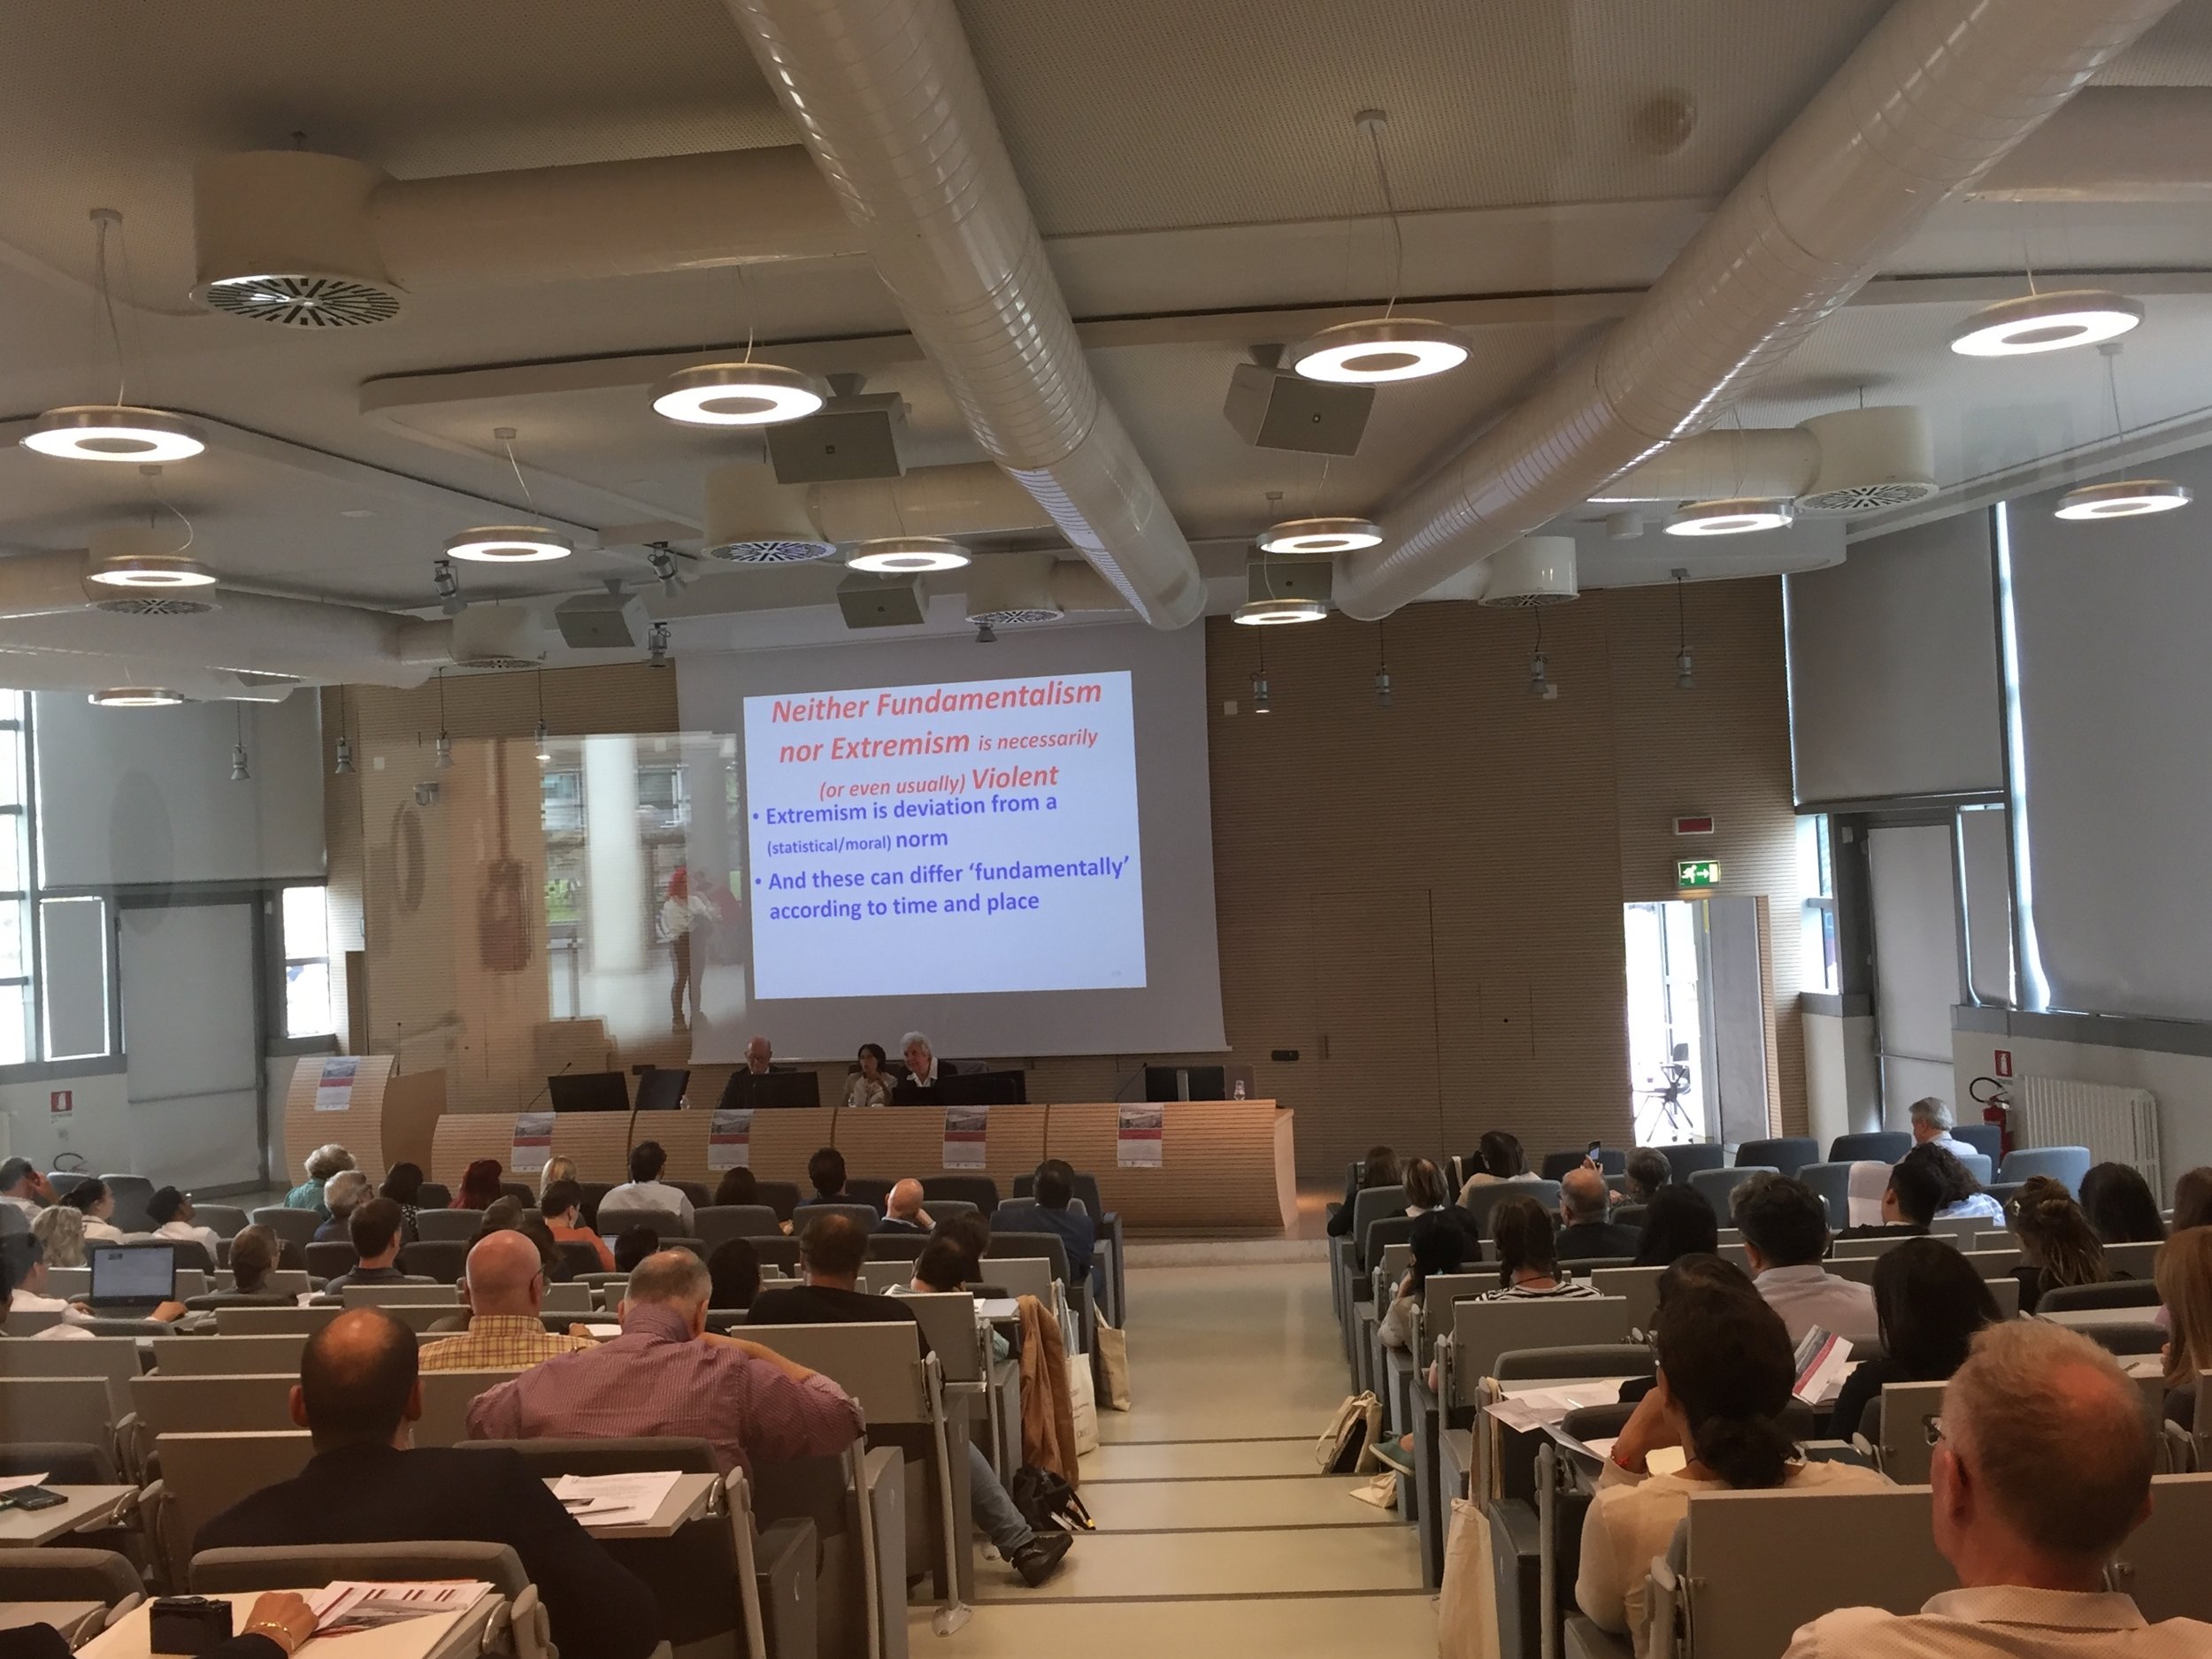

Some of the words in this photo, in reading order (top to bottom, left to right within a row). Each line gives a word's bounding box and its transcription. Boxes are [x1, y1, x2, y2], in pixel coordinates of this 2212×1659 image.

[772, 696, 869, 723] Neither
[877, 680, 1102, 716] Fundamentalism
[780, 743, 824, 763] nor
[832, 731, 969, 760] Extremism
[979, 735, 992, 750] is
[998, 728, 1098, 749] necessarily
[820, 782, 845, 802] (or
[849, 783, 890, 796] even
[896, 774, 965, 795] usually)
[972, 765, 1059, 789] Violent
[766, 804, 866, 825] Extremism
[873, 802, 887, 819] is
[894, 797, 985, 818] deviation
[991, 794, 1039, 812] from
[1046, 796, 1056, 810] a
[768, 835, 891, 856] (statistical/moral)
[896, 833, 948, 848] norm
[769, 871, 806, 890] And
[812, 870, 864, 887] these
[871, 872, 903, 886] can
[910, 864, 963, 884] differ
[770, 900, 862, 920] according
[867, 900, 887, 916] to
[893, 897, 937, 915] time
[944, 893, 979, 912] and
[987, 892, 1039, 915] place
